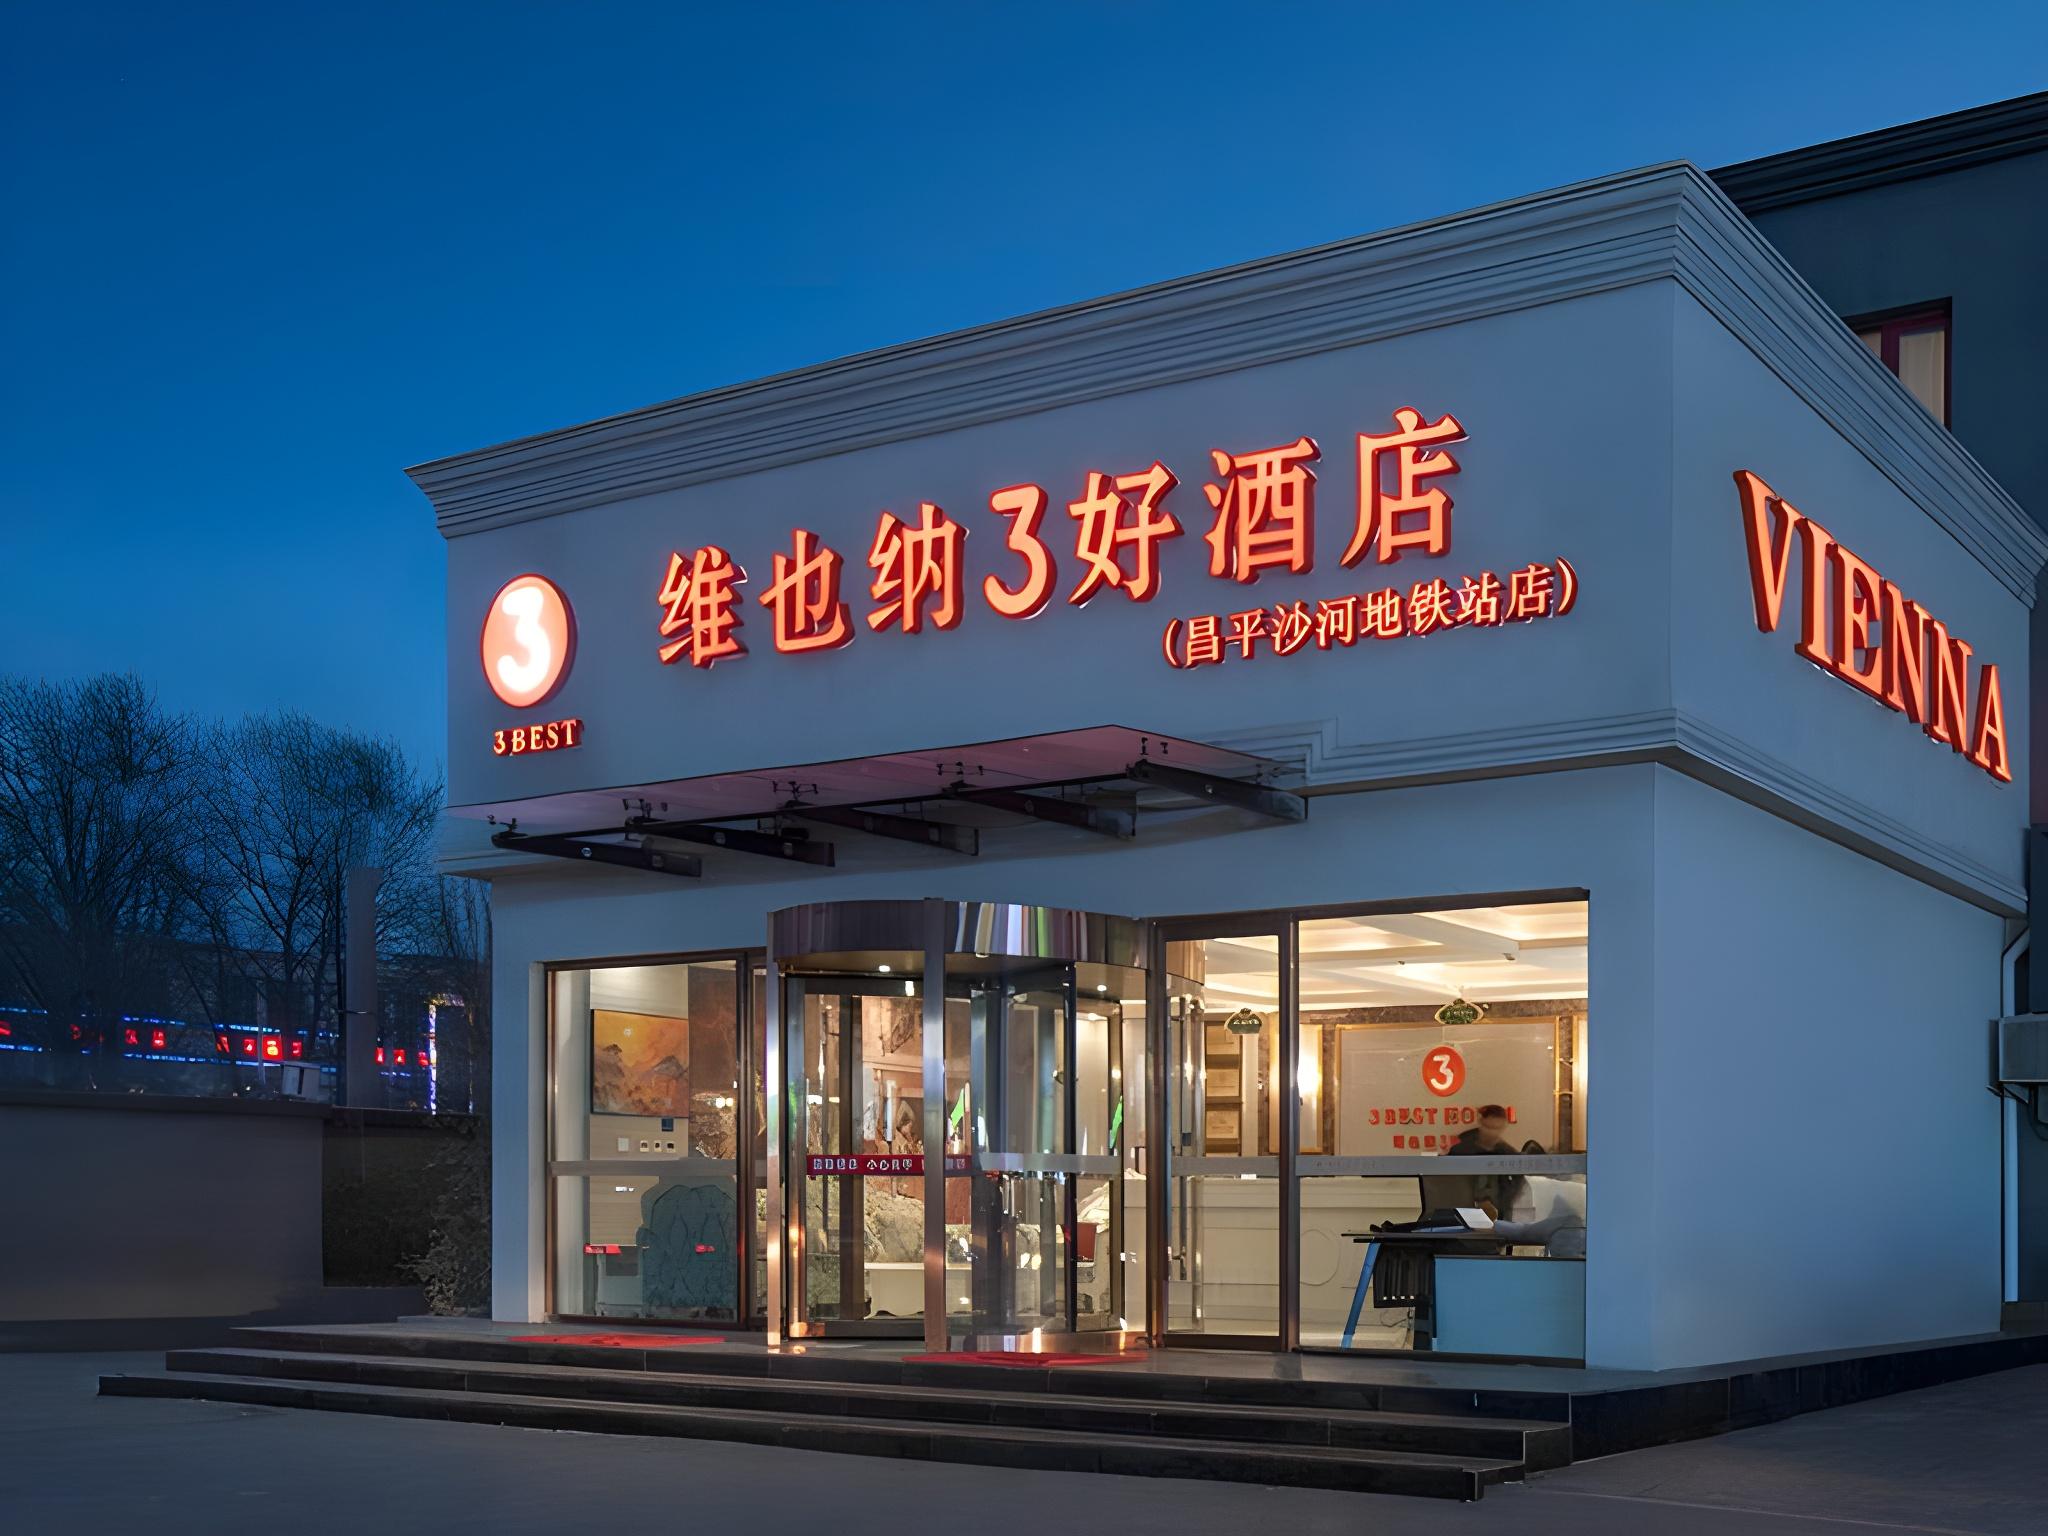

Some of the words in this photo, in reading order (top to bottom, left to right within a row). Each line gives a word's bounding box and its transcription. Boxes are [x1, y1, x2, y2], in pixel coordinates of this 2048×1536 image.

[657, 407, 1469, 668] 维也纳3好酒店
[1162, 556, 1579, 669] (昌平沙河地铁站店)
[1733, 469, 2012, 783] VIENNA
[1429, 1053, 1455, 1091] 3
